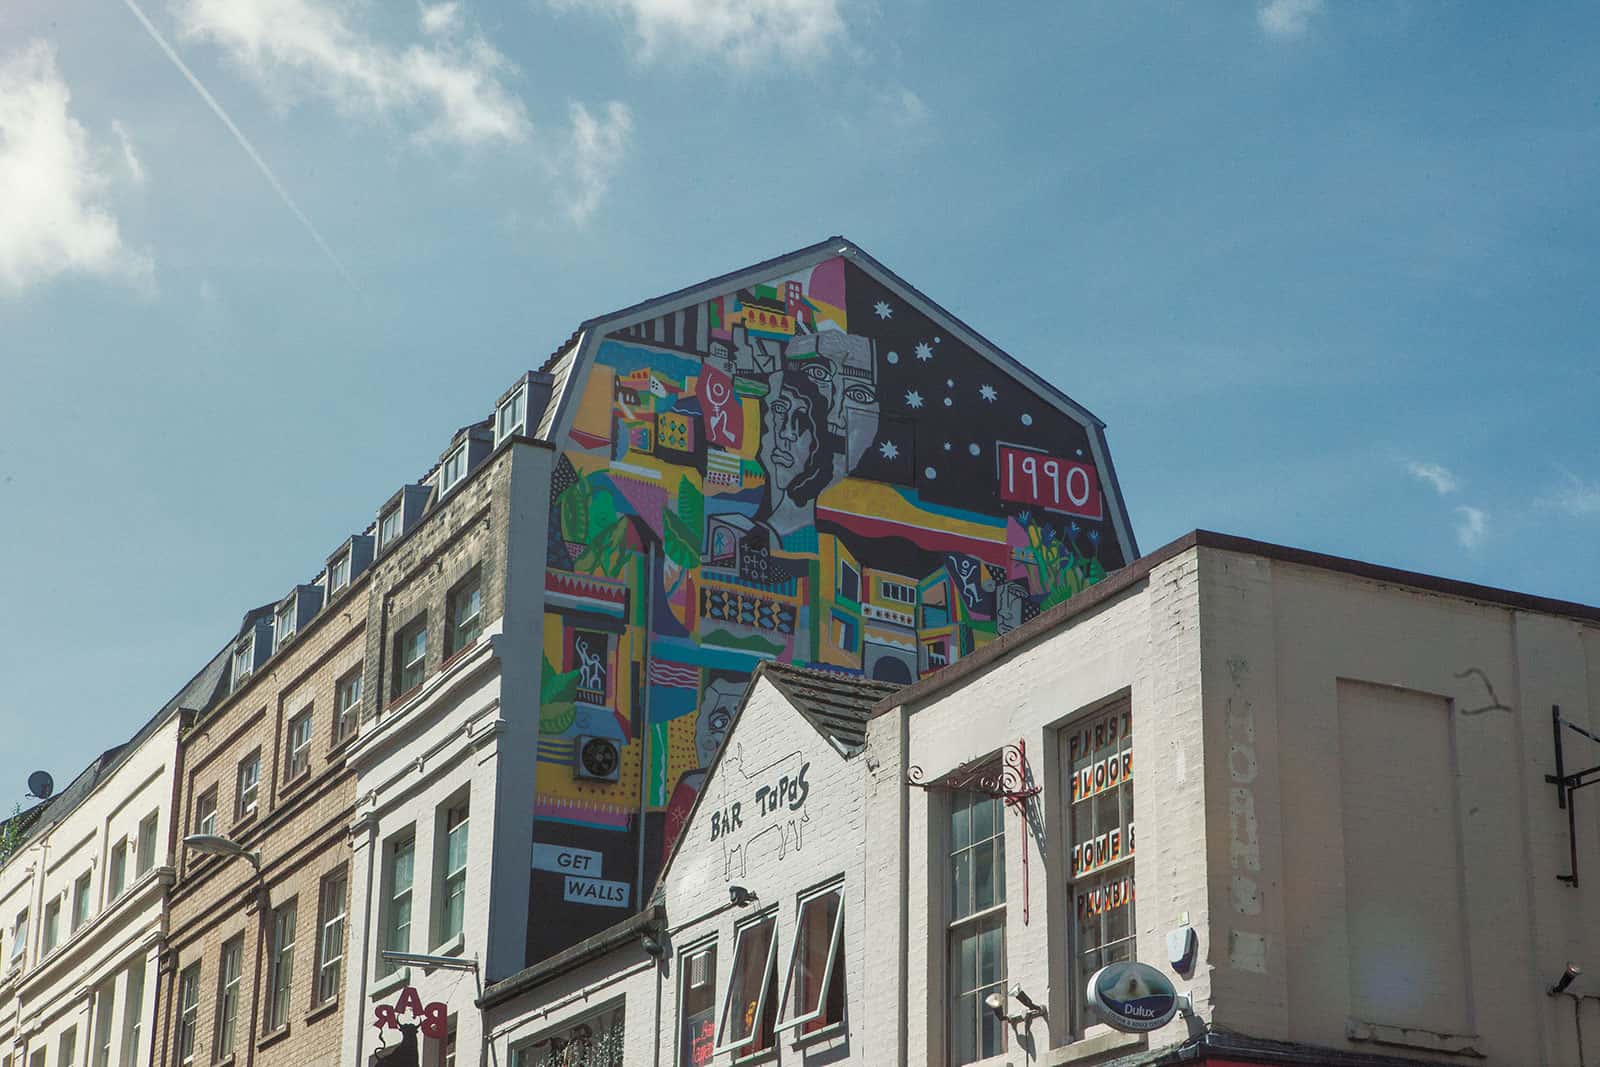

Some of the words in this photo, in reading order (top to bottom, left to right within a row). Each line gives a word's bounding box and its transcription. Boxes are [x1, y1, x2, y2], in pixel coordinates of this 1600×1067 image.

[1008, 453, 1090, 507] 1990
[1070, 713, 1132, 758] FIRST
[1070, 752, 1132, 799] FLOOR
[710, 801, 743, 842] BAR
[556, 852, 592, 870] GET
[1071, 831, 1120, 876] HOME
[568, 880, 624, 902] WALLS
[1124, 1003, 1155, 1017] Dulux
